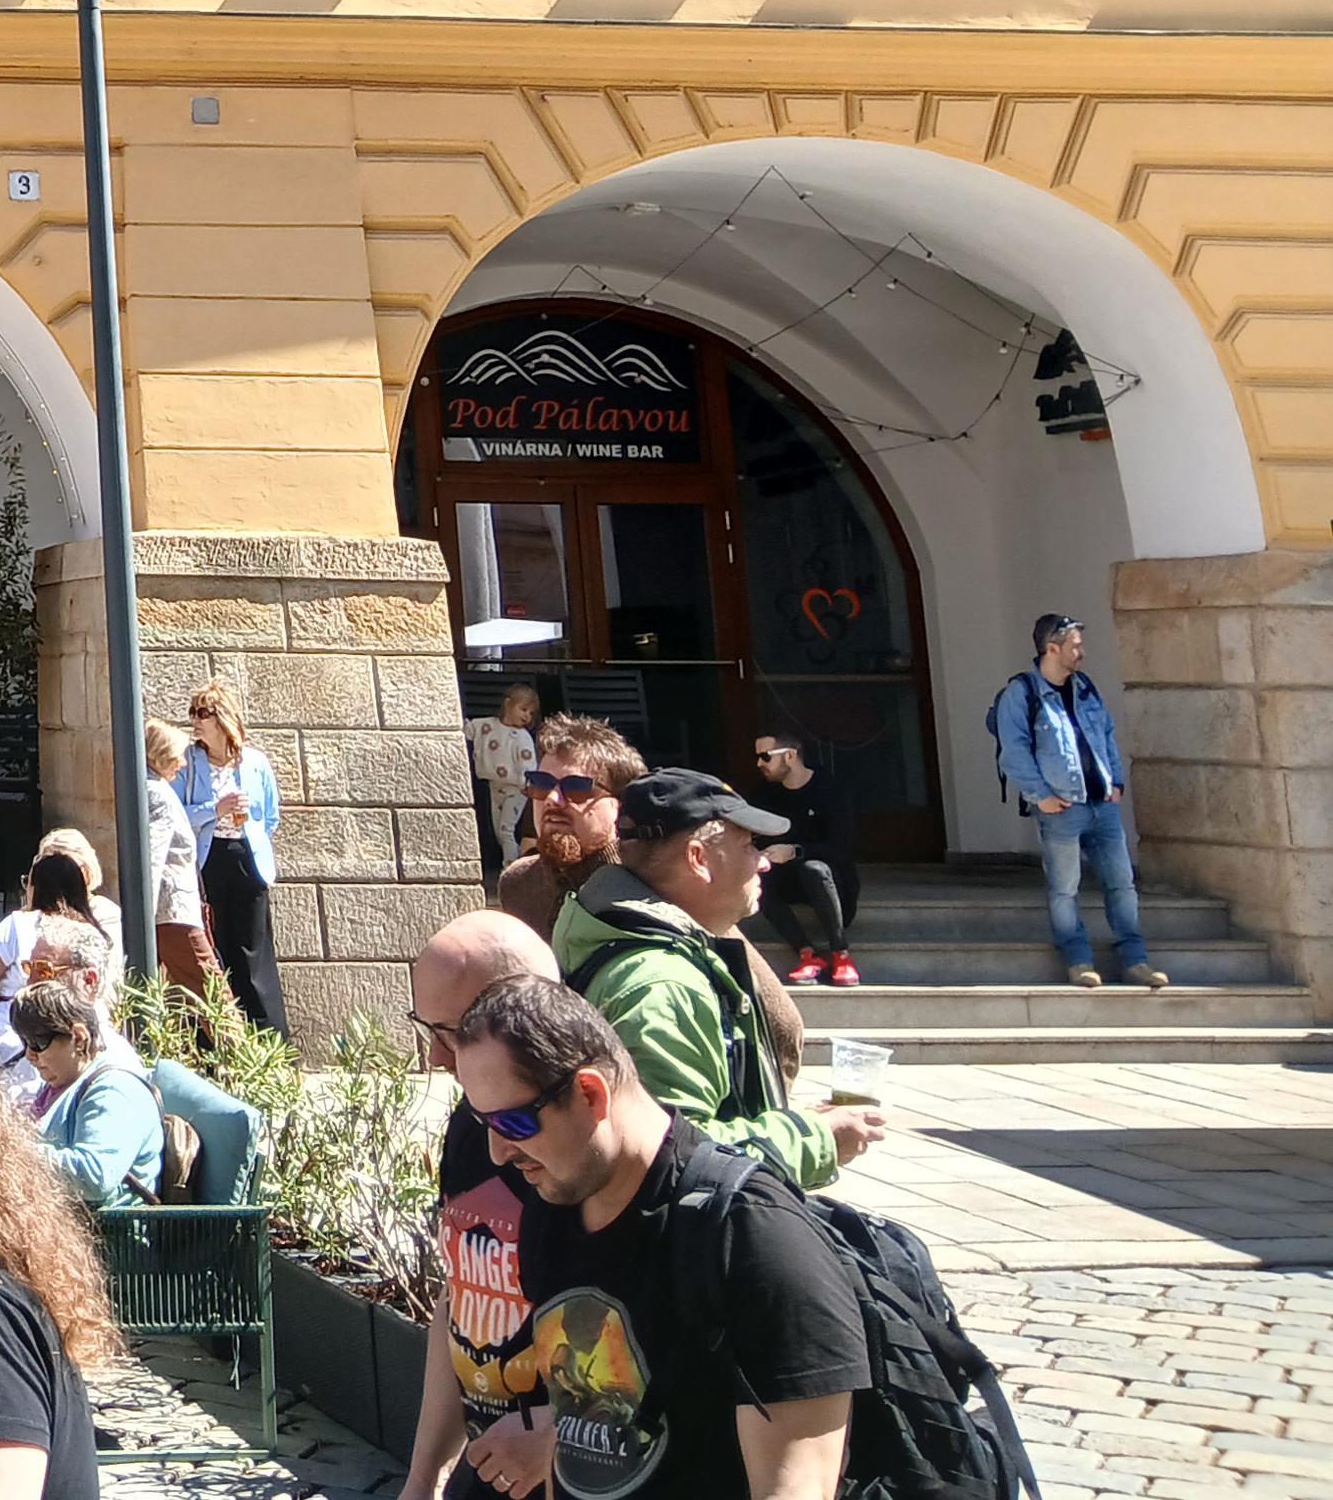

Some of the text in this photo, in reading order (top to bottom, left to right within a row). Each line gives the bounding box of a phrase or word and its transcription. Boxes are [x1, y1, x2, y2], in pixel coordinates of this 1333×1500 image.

[18, 175, 31, 195] 3
[448, 395, 692, 433] Pod Pálavou
[482, 439, 563, 457] VINÁRNA
[576, 443, 623, 458] WINE
[627, 445, 664, 459] BAR
[459, 1230, 524, 1297] ANGE
